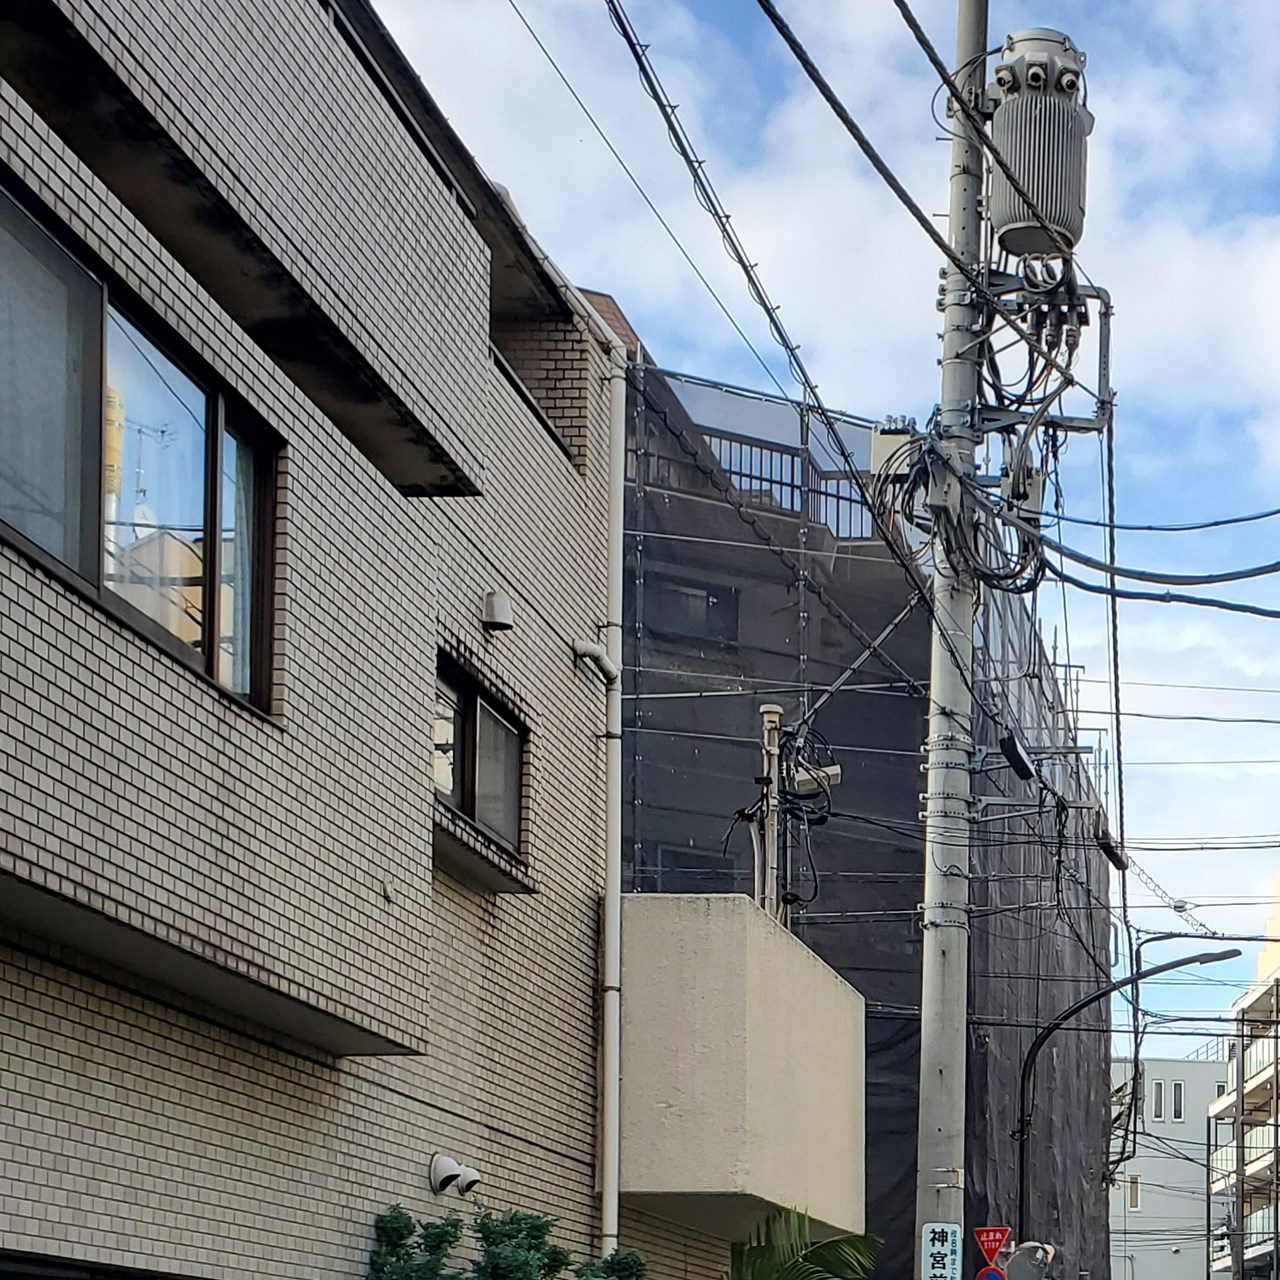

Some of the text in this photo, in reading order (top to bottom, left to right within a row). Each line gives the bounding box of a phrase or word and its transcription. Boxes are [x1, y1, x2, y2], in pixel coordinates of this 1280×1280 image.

[980, 1231, 1003, 1241] 止まれ
[984, 1241, 1000, 1249] STOP
